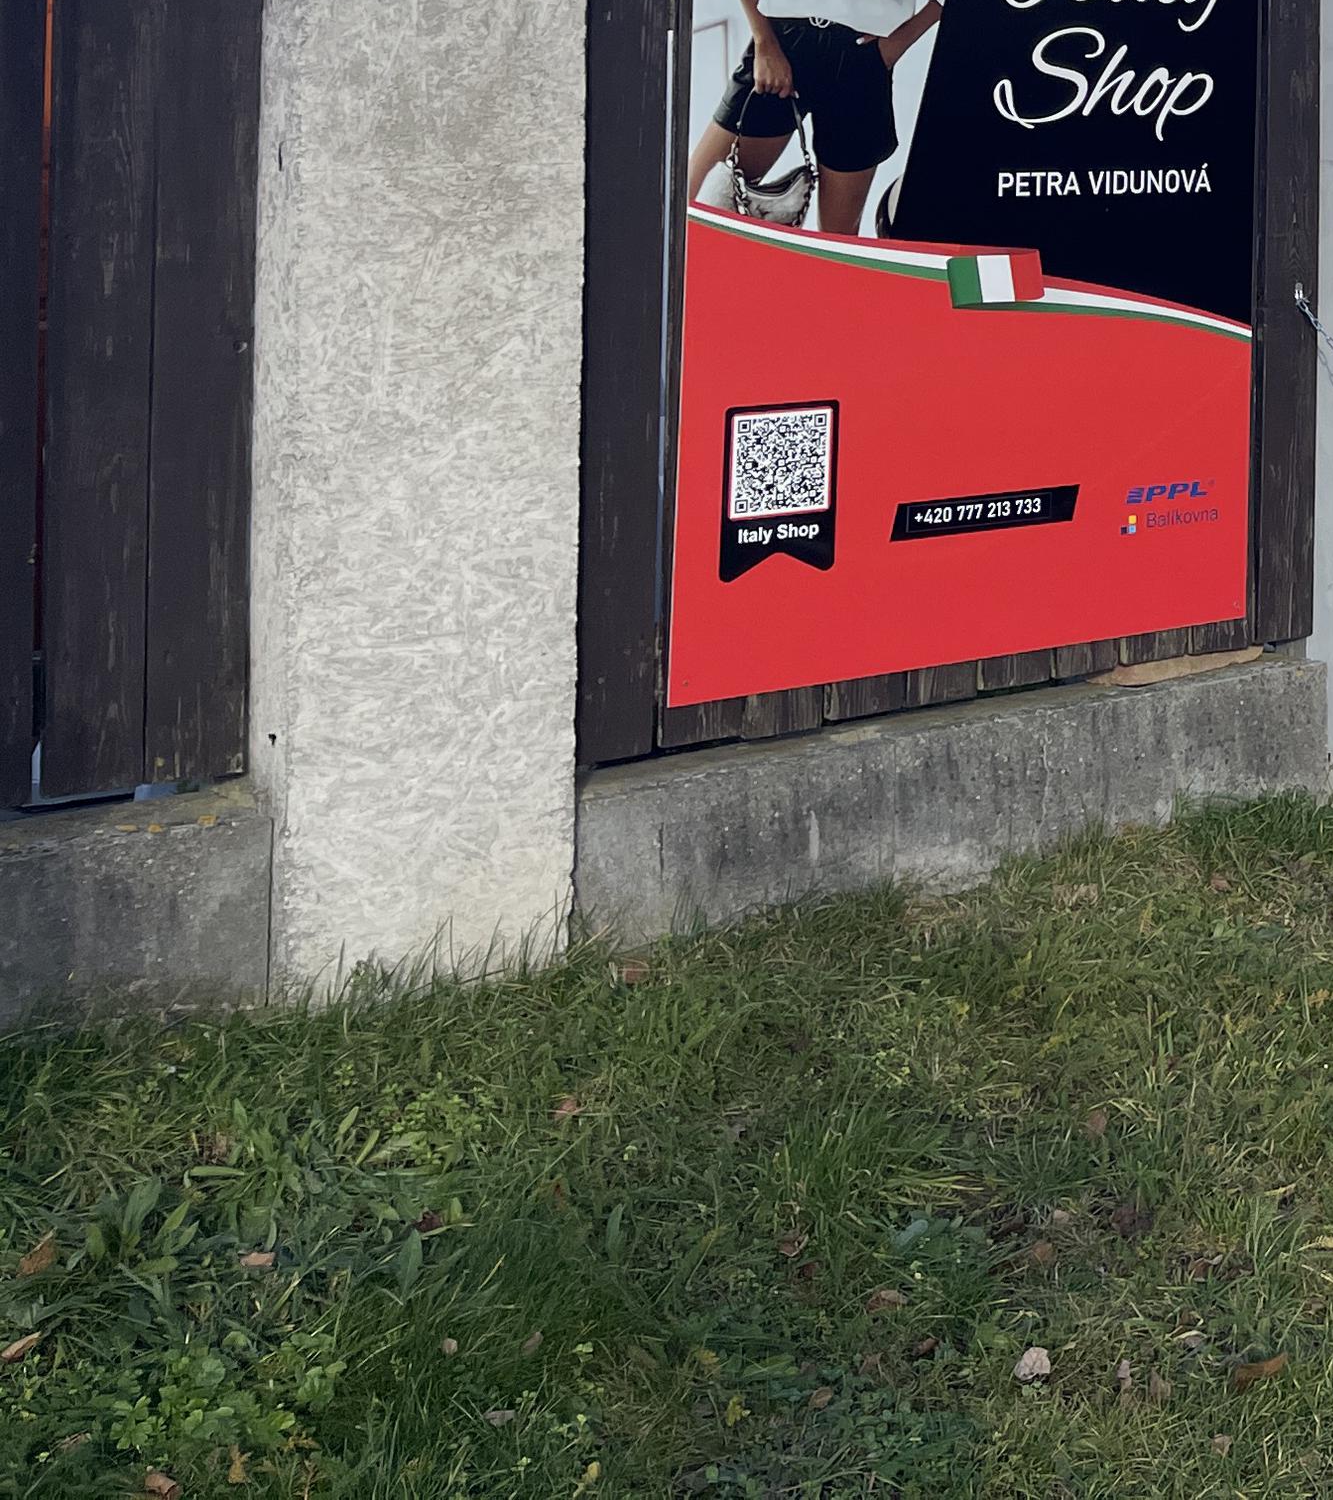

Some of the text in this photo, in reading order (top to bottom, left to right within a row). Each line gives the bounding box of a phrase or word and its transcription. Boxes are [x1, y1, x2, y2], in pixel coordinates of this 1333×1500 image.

[992, 26, 1215, 141] Shop
[997, 162, 1212, 198] PETRA VIDUNOVÁ
[1145, 481, 1208, 502] PPL
[914, 497, 1041, 524] +420 777 213 733
[737, 523, 819, 545] Italy Shop
